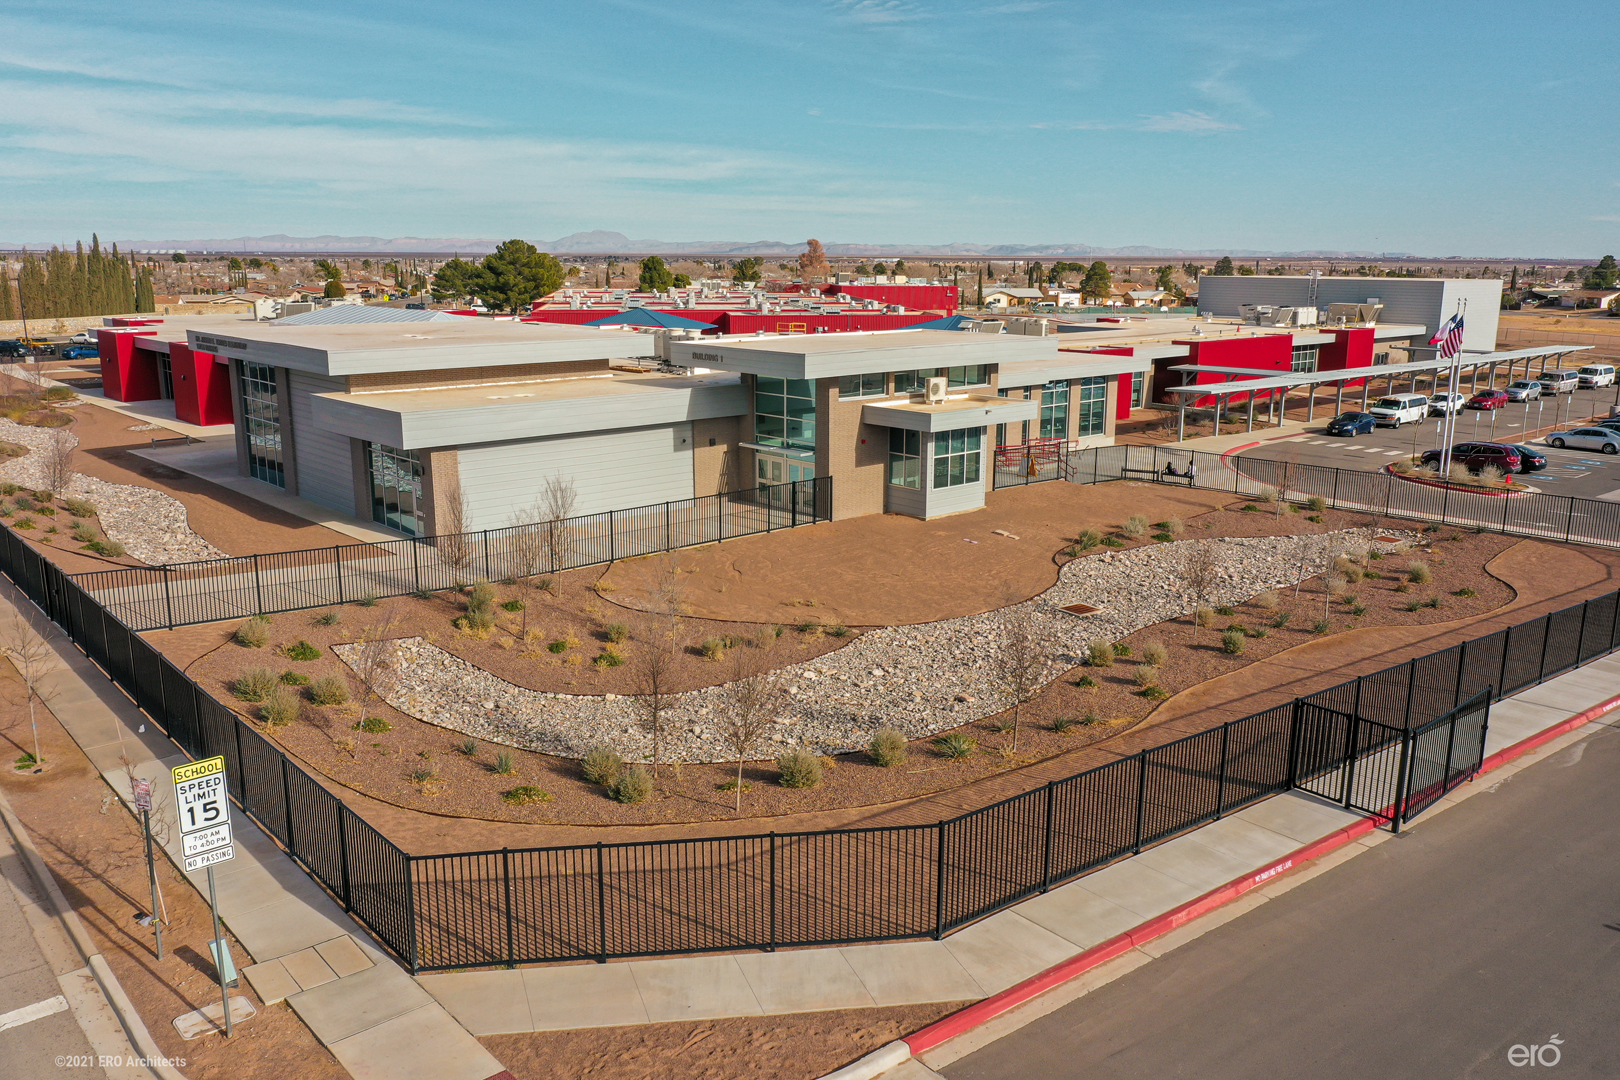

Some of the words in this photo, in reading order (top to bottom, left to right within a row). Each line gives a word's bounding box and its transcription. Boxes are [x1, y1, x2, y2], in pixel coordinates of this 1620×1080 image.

[692, 352, 718, 362] BUILDING
[176, 762, 222, 780] SCHOOL
[179, 777, 221, 795] SPEED
[185, 788, 217, 804] LIMIT
[187, 800, 220, 826] 15
[193, 834, 208, 842] 7:00
[200, 840, 215, 848] 4:00
[187, 860, 198, 868] NO
[201, 849, 231, 864] PASSING
